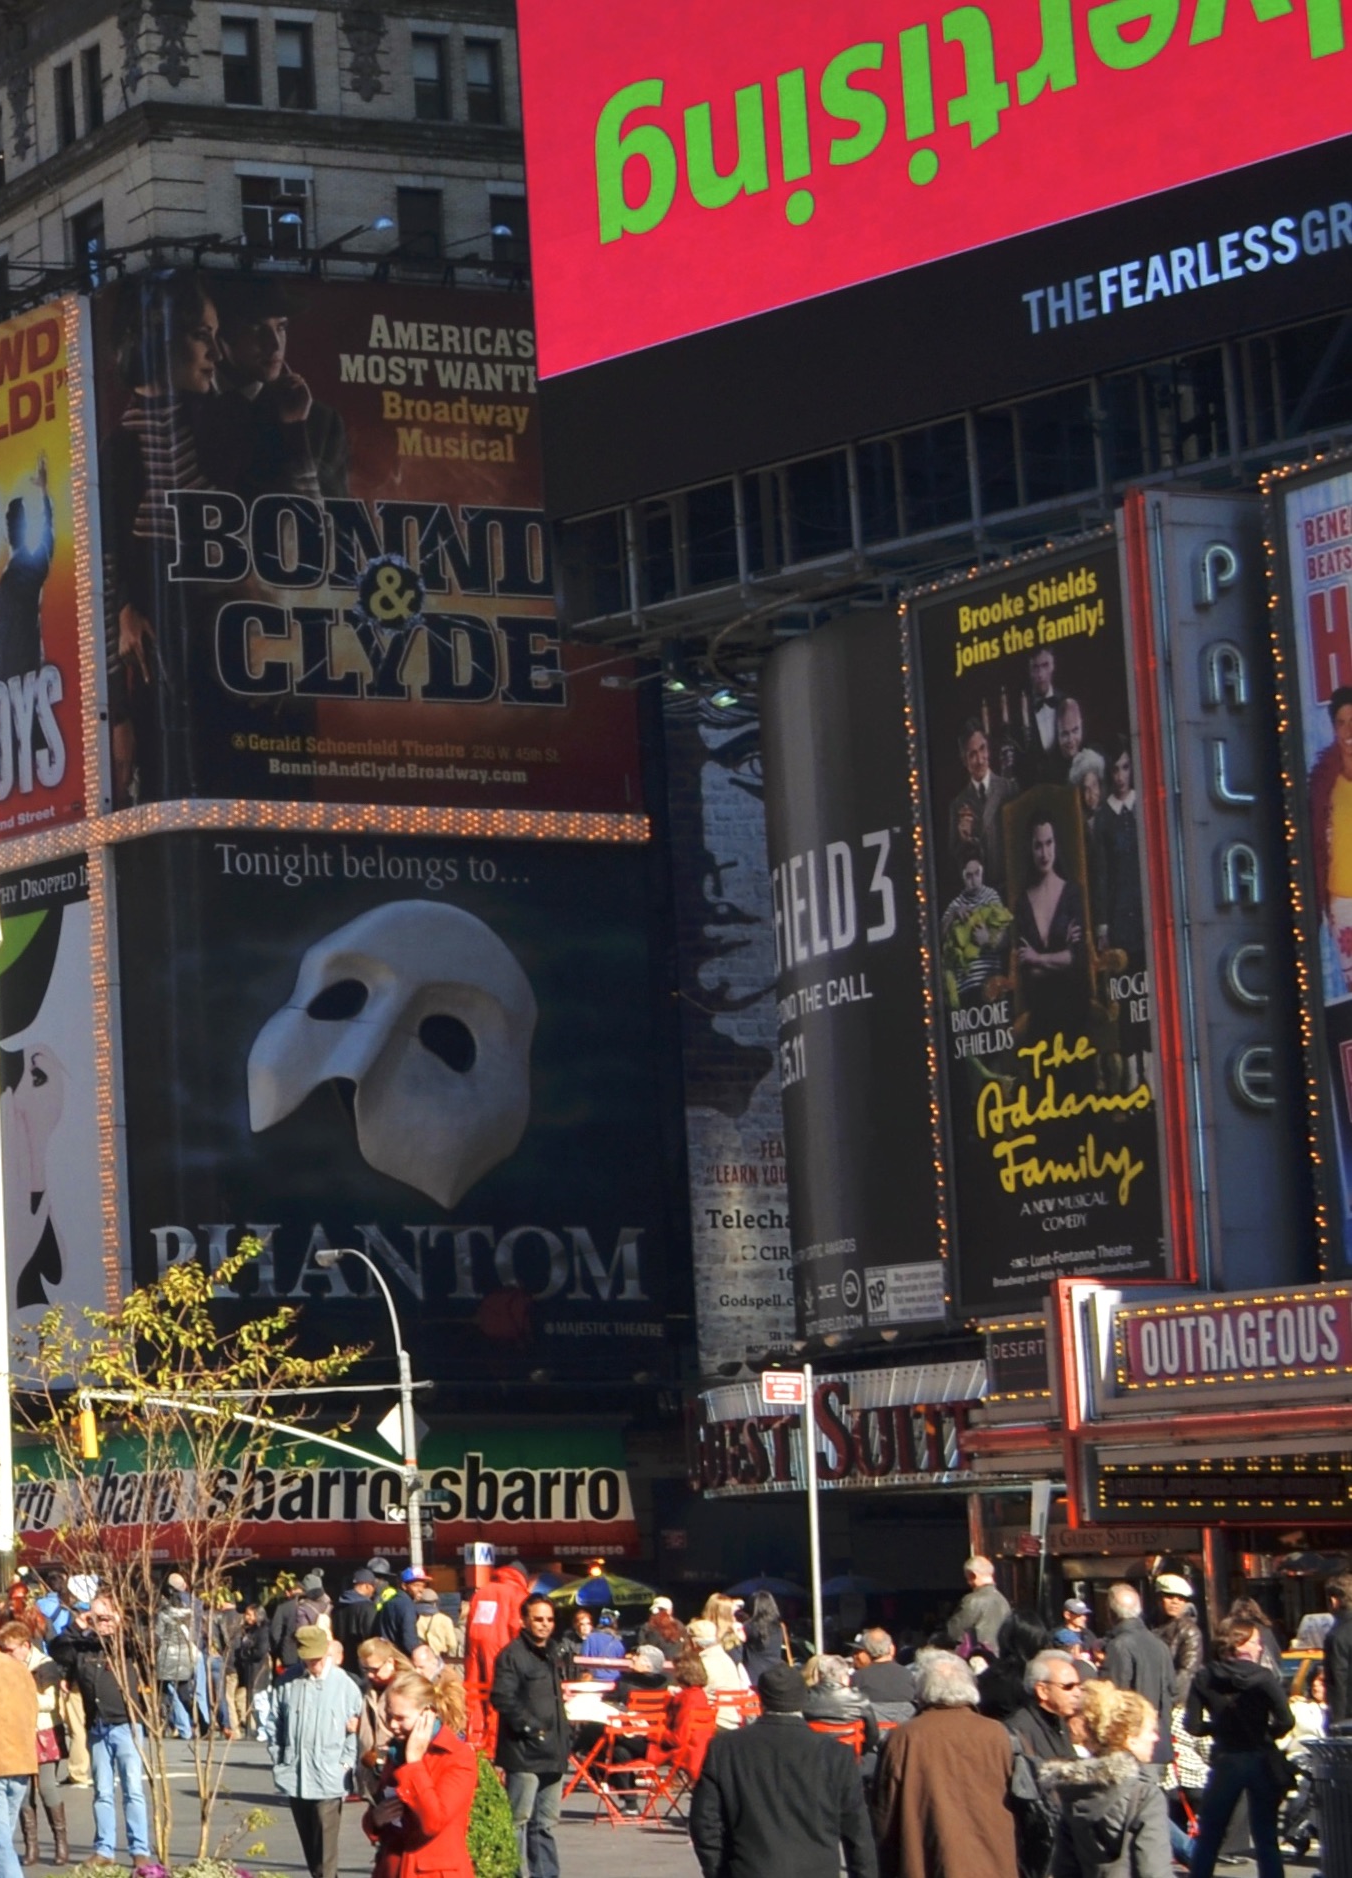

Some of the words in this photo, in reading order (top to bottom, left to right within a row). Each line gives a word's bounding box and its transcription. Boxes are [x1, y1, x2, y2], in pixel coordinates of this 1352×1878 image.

[368, 314, 534, 358] AMERICA'S
[339, 354, 429, 387] MOST
[382, 390, 529, 434] Broadway
[397, 427, 515, 463] Musical
[370, 566, 415, 622] &
[958, 587, 1024, 635] Brooke
[1028, 567, 1097, 609] Shields
[215, 601, 567, 707] CLYDE
[955, 635, 1000, 677] joins
[1003, 619, 1035, 652] the
[1037, 598, 1105, 646] family!
[248, 733, 300, 753] Gerald
[402, 740, 465, 760] Theatre
[269, 757, 527, 784] BonnieAndClydeBroadway.com
[17, 805, 56, 827] Street
[1204, 543, 1278, 1108] PALACE
[214, 842, 334, 887] Tonight
[342, 844, 459, 890] belongs
[20, 871, 77, 901] DROPPED
[860, 828, 898, 945] 3
[826, 979, 874, 1012] CALL
[951, 999, 1010, 1033] BROOKE
[954, 1026, 1014, 1060] SHIELDS
[1017, 1031, 1097, 1080] The
[975, 1073, 1153, 1139] Addams
[992, 1132, 1145, 1207] Family
[1033, 1197, 1055, 1215] NEW
[1057, 1191, 1108, 1210] MUSICAL
[1041, 1212, 1090, 1232] COMEDY
[150, 1223, 648, 1301] PHANTOM
[1097, 1242, 1133, 1263] Theatre
[868, 1279, 887, 1310] RP
[614, 1321, 665, 1338] THEATRE
[1140, 1305, 1340, 1378] OUTRAGEOUS
[993, 1340, 1045, 1360] DESERT
[205, 1451, 409, 1522] sbarro
[428, 1451, 621, 1522] sbarro
[291, 1547, 335, 1557] PASTA
[553, 1545, 625, 1556] ESPRESSO
[1106, 1528, 1157, 1546] SUITES
